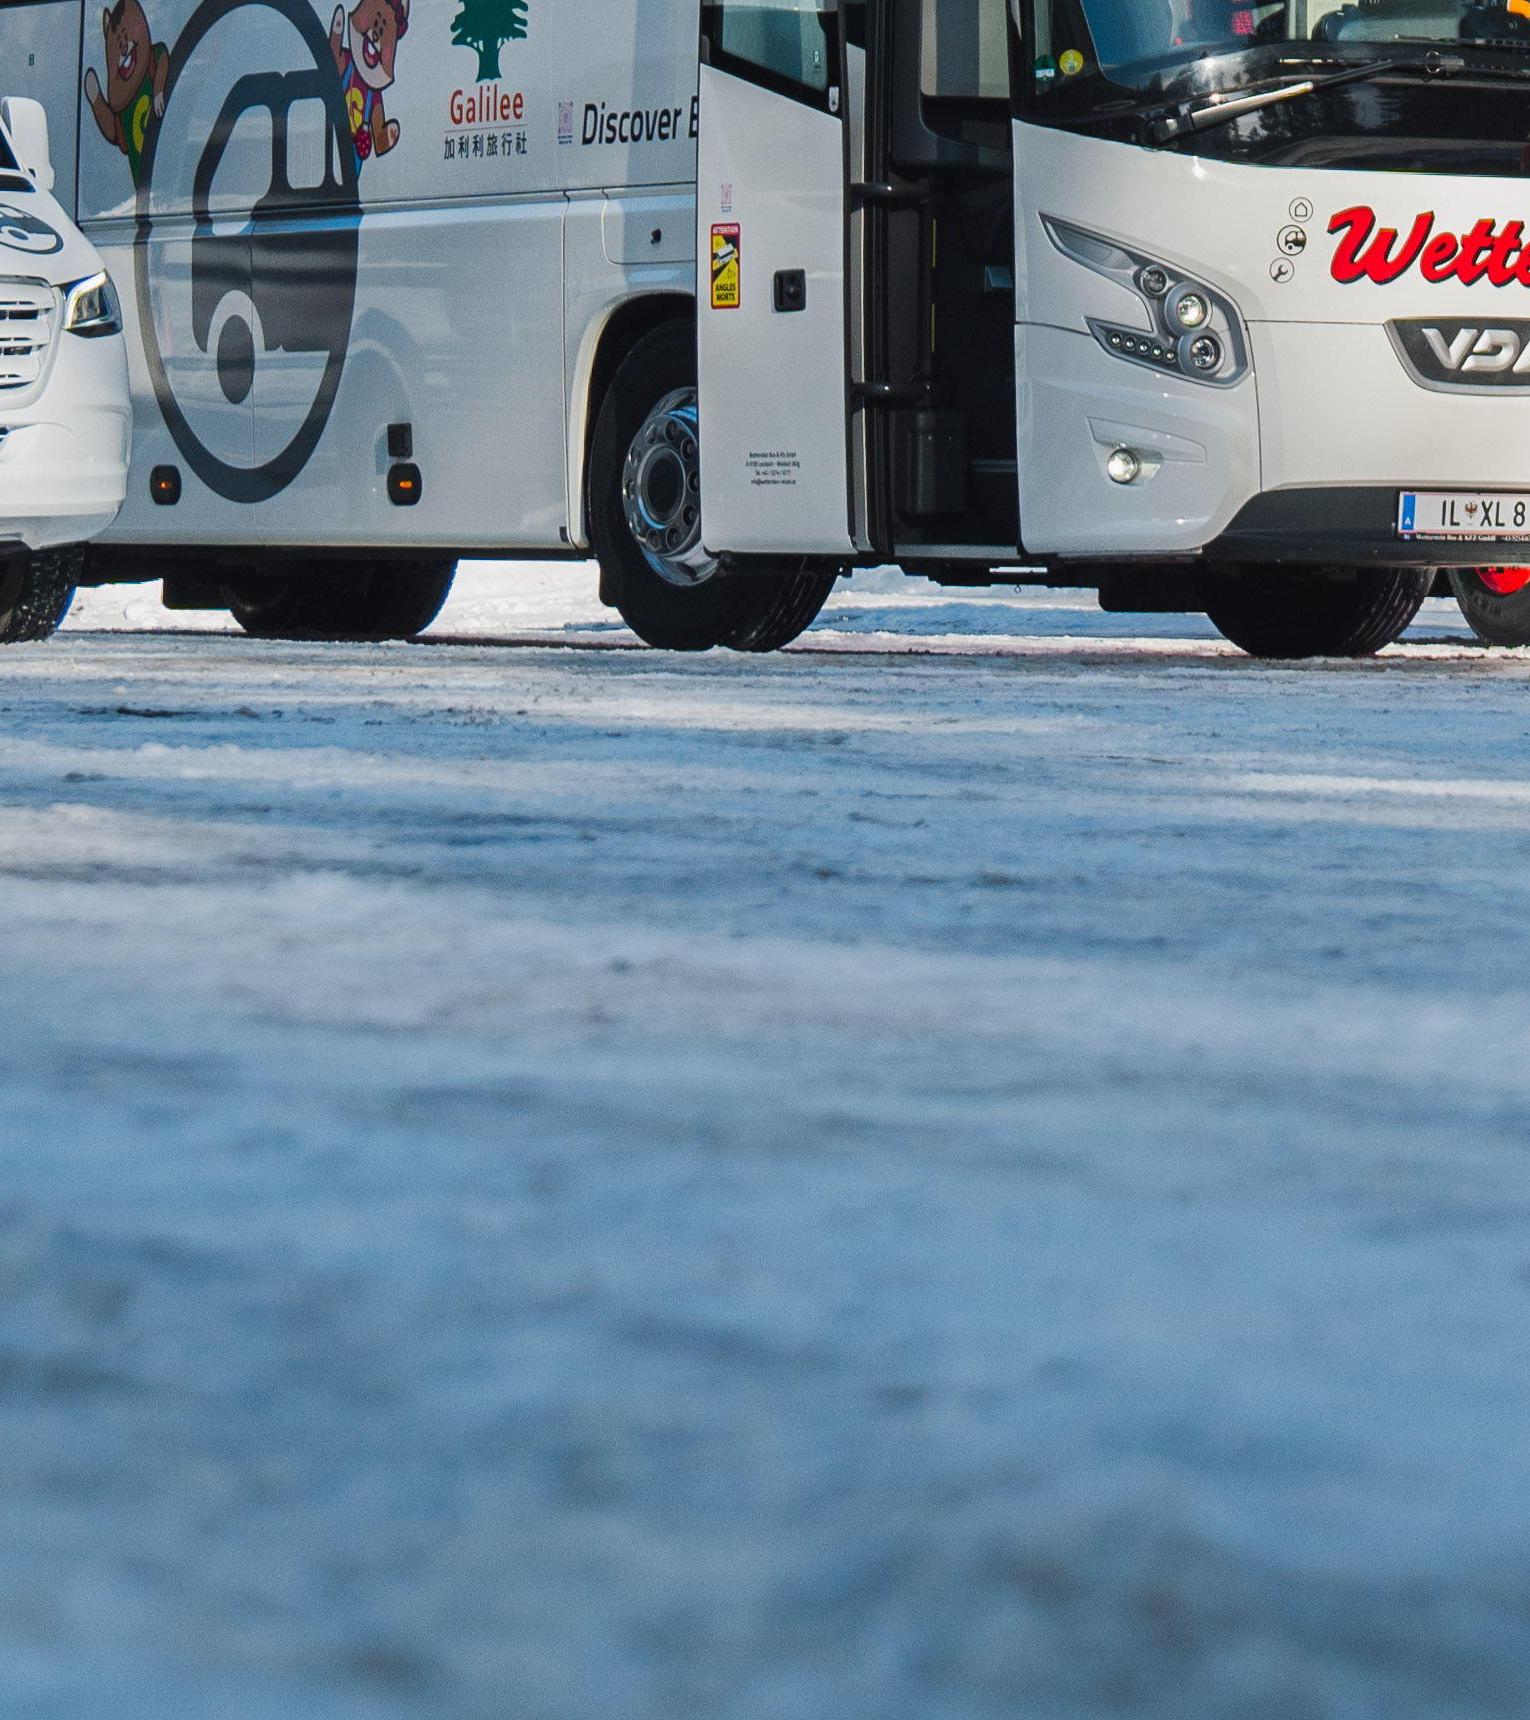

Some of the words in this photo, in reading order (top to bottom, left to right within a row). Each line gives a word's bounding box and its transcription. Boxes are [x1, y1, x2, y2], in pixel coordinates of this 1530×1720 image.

[449, 83, 525, 125] Galilee
[581, 101, 683, 146] Discover
[443, 131, 528, 160] 加利利旅行社
[1404, 516, 1412, 525] A
[1441, 499, 1461, 527] IL
[1479, 500, 1506, 527] XL
[1513, 501, 1526, 527] 8
